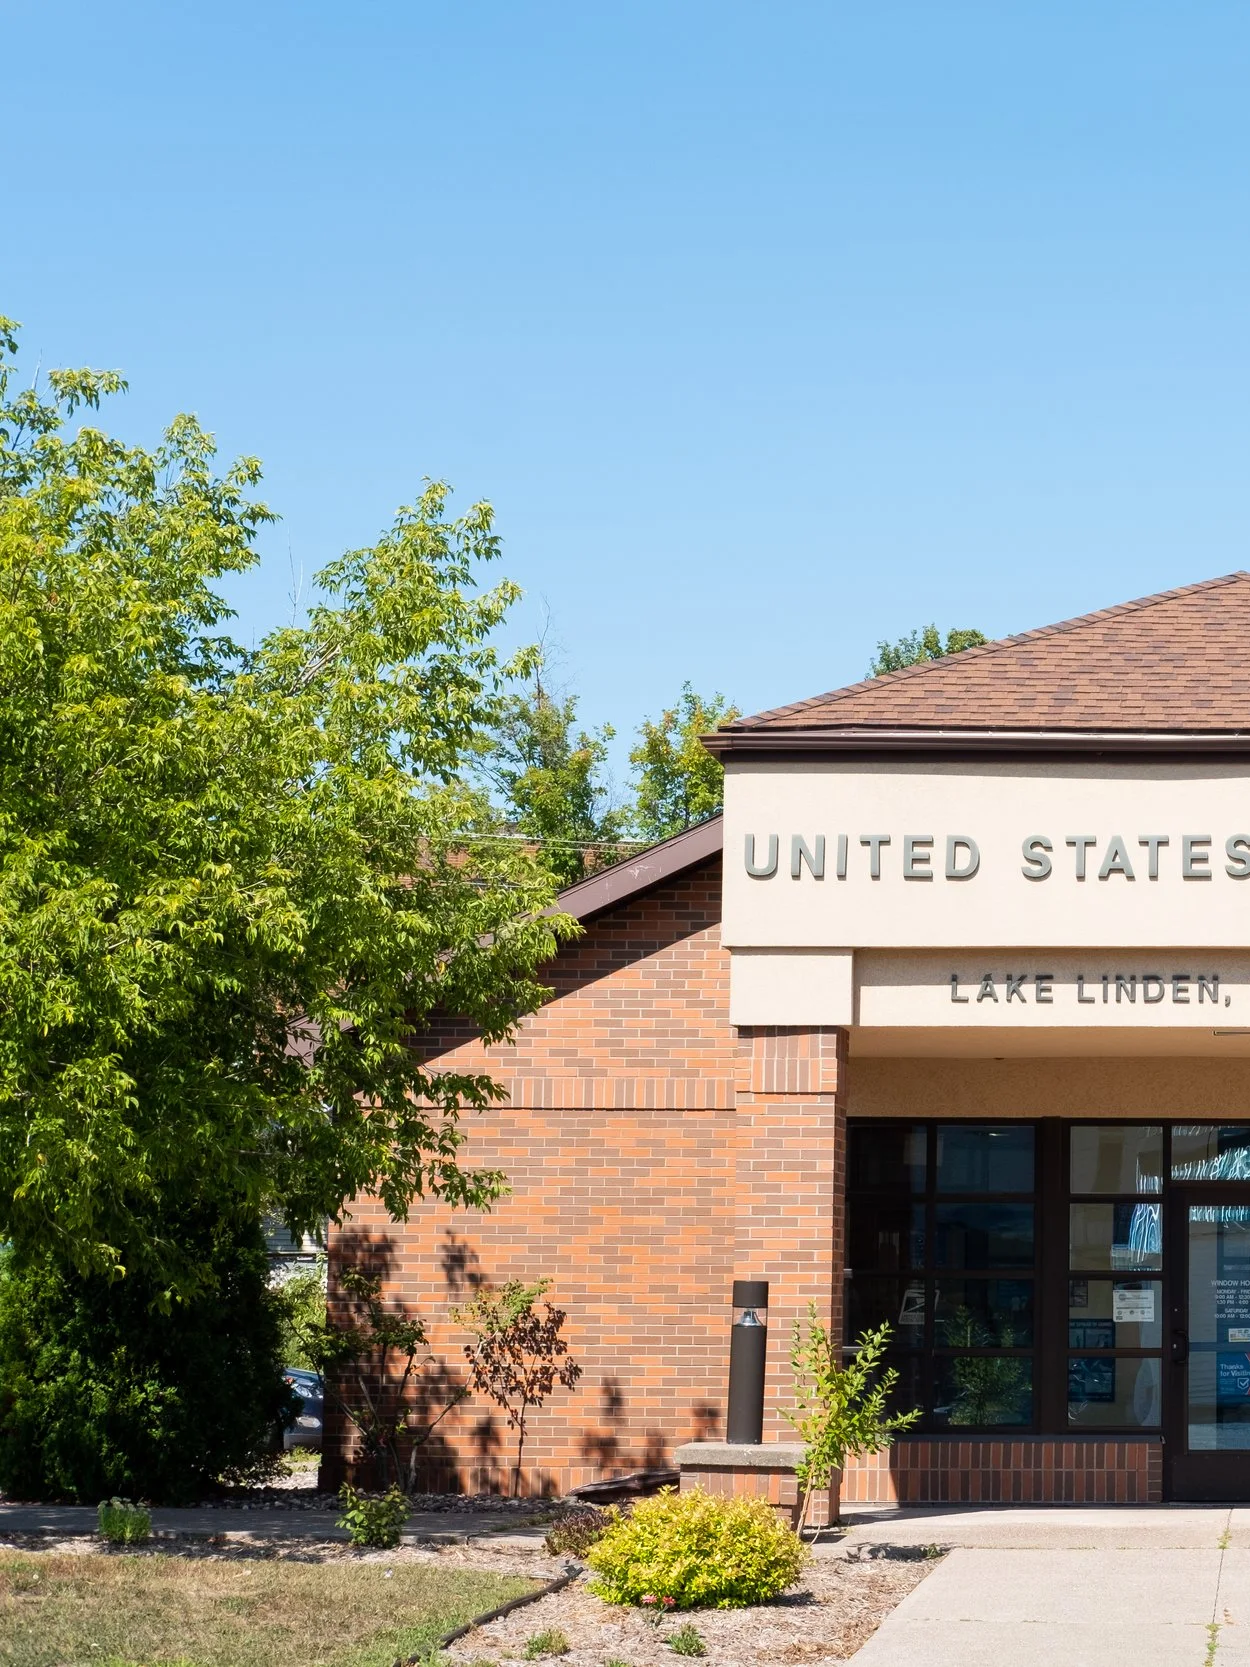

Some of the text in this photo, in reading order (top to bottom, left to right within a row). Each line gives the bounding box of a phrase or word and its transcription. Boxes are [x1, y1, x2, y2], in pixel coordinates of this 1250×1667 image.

[744, 833, 981, 880] UNITED
[951, 973, 1054, 1003] LAKE
[1077, 973, 1232, 1007] LINDEN,
